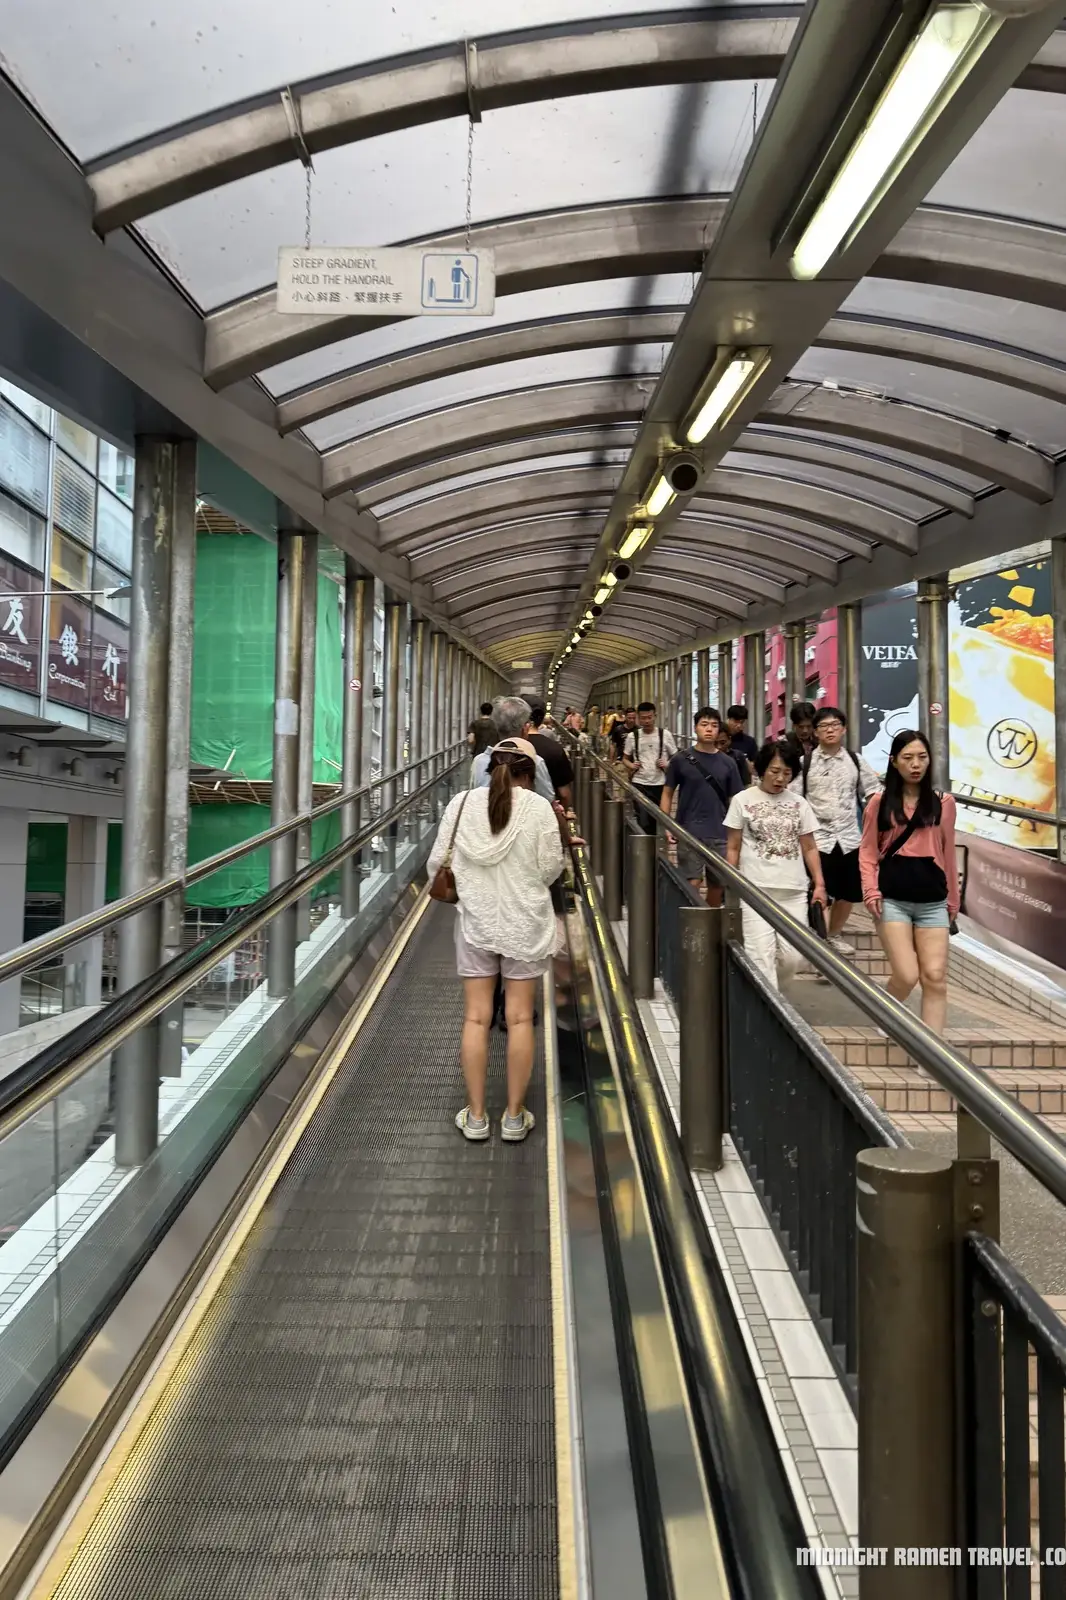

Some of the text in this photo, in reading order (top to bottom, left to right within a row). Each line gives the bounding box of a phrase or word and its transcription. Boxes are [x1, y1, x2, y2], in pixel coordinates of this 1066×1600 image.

[292, 257, 324, 269] STEEP
[291, 273, 394, 286] HOLD THE HANDRAIL
[861, 645, 919, 660] VETEA
